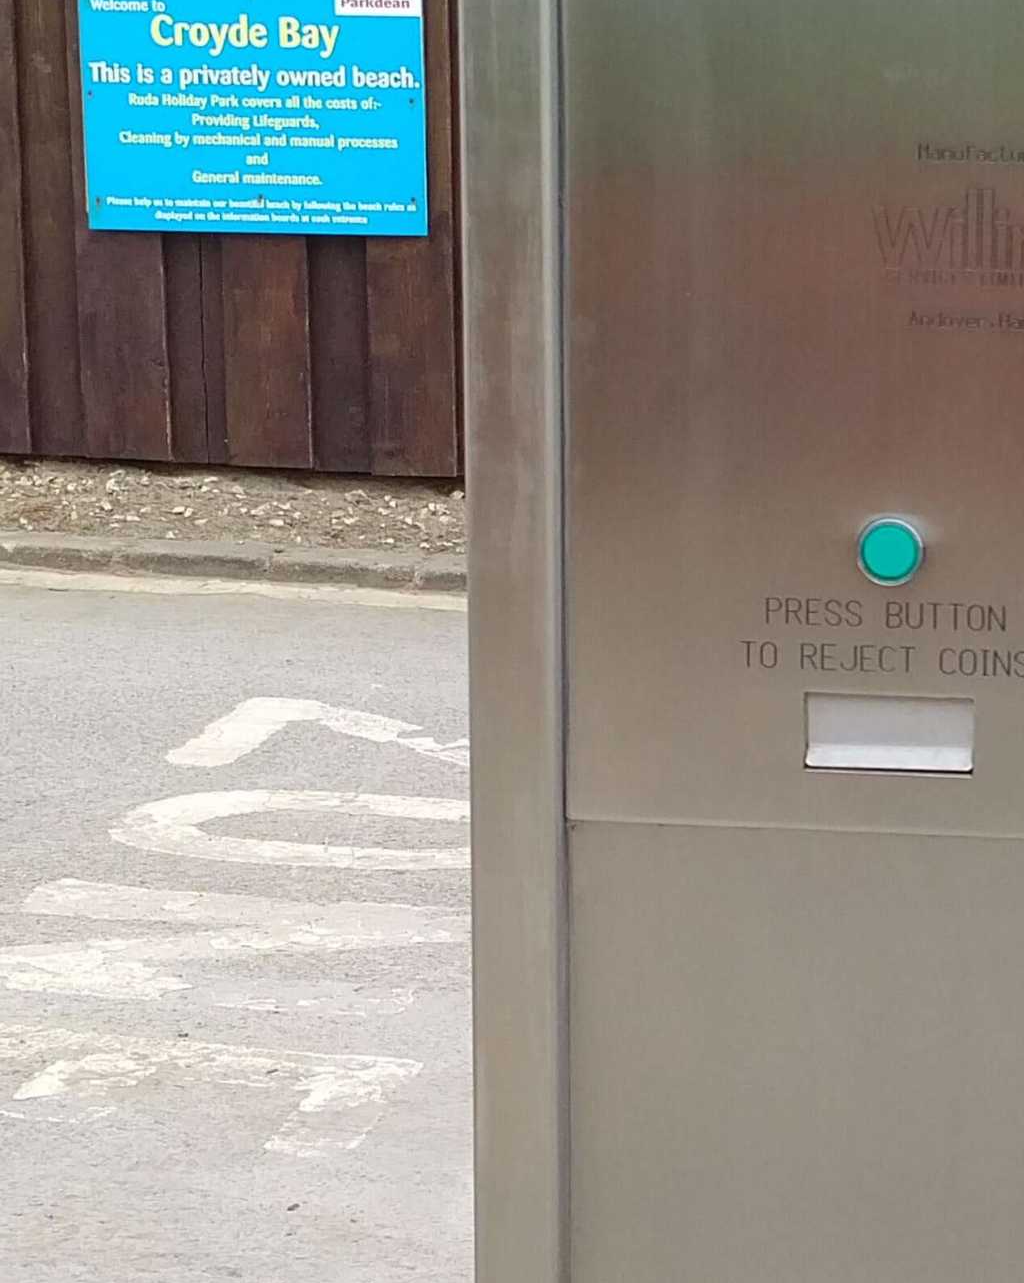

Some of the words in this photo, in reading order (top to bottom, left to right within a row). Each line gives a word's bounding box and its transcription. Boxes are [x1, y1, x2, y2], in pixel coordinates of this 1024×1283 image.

[151, 0, 166, 12] to
[150, 13, 268, 57] Croyde
[278, 16, 340, 59] Bay
[88, 61, 131, 83] This
[137, 63, 154, 84] is
[160, 68, 173, 84] a
[179, 64, 270, 92] privately
[276, 65, 347, 87] owned
[352, 66, 420, 89] beach.
[162, 93, 207, 110] Holiday
[210, 95, 239, 108] Park
[242, 97, 282, 109] covers
[285, 96, 300, 109] all
[303, 96, 322, 109] the
[325, 97, 357, 110] costs
[191, 113, 250, 130] Providing
[119, 130, 172, 148] Cleaning
[174, 131, 190, 148] by
[192, 133, 261, 146] mechanical
[264, 134, 287, 146] and
[290, 134, 335, 147] manual
[337, 137, 398, 151] processes
[246, 152, 269, 165] and
[191, 170, 240, 184] General
[764, 597, 863, 628] PRESS
[885, 601, 1007, 632] BUTTON
[740, 640, 778, 669] TO
[800, 643, 916, 673] REJECT
